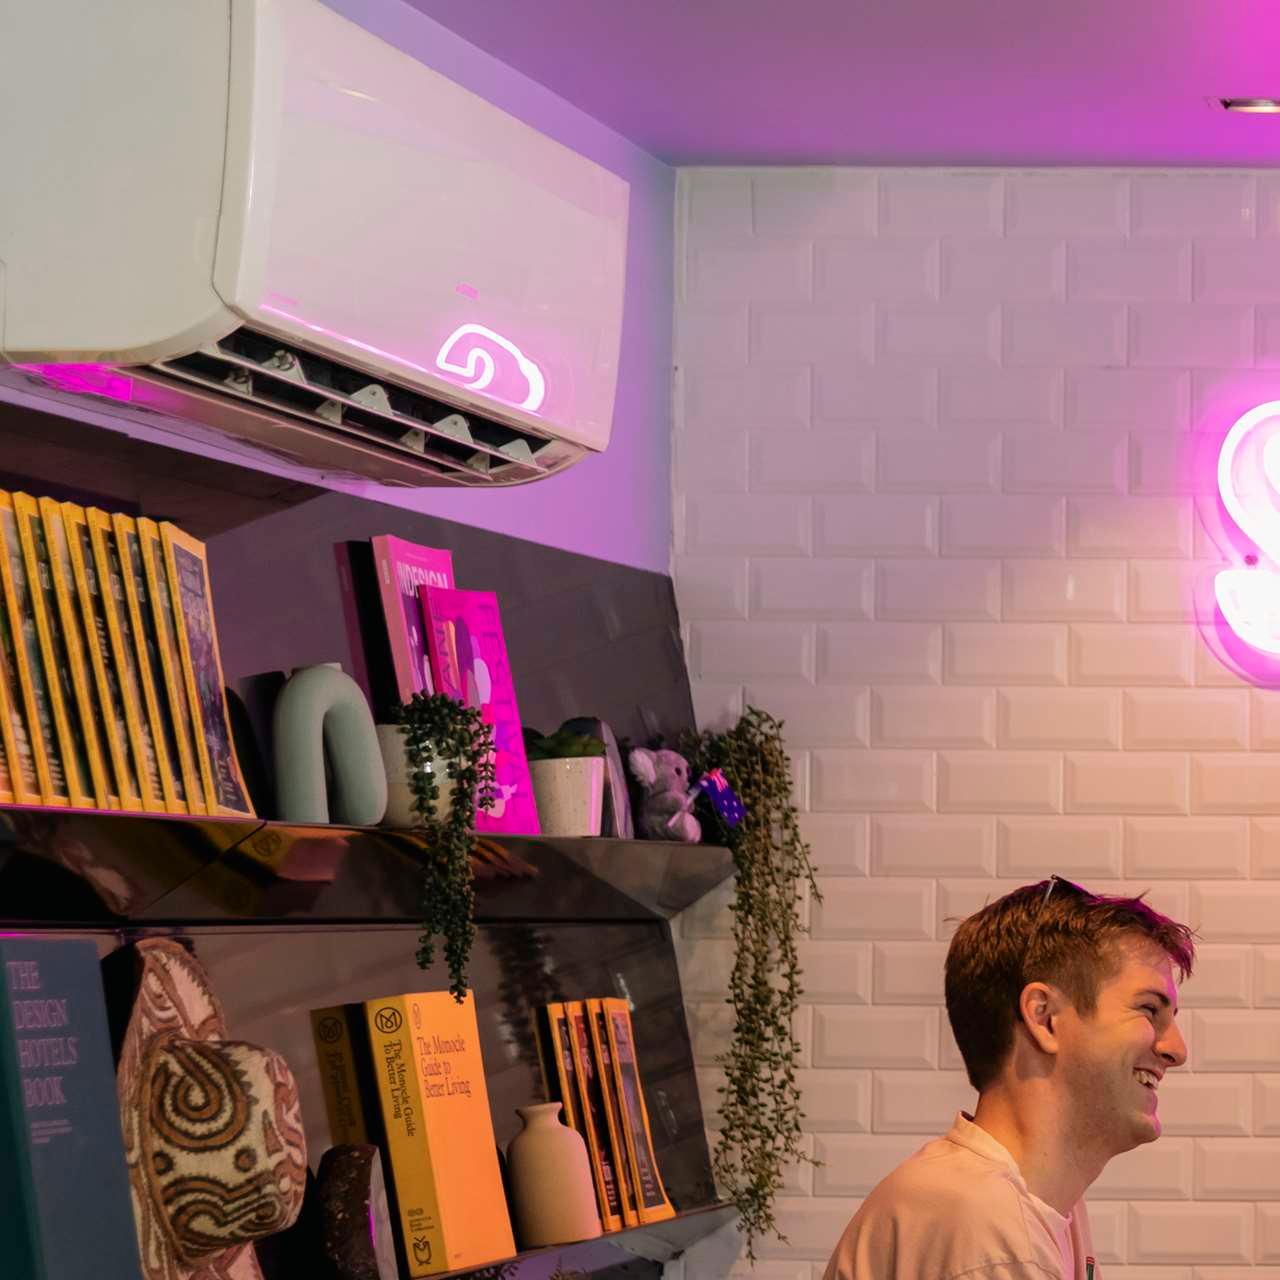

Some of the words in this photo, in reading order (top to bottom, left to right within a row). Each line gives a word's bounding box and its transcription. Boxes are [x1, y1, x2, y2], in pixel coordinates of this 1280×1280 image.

[6, 961, 41, 990] THE
[12, 999, 69, 1029] DESIGN
[17, 1037, 79, 1068] HOTELS
[384, 1040, 393, 1055] To
[391, 1039, 401, 1061] The
[417, 1036, 432, 1056] The
[432, 1033, 467, 1054] Monocle
[385, 1055, 398, 1086] Better
[420, 1058, 442, 1077] Guide
[23, 1076, 67, 1107] BOOK
[395, 1061, 410, 1106] Monocle
[424, 1079, 445, 1099] Better
[445, 1077, 472, 1098] Living
[391, 1086, 402, 1120] Living
[403, 1107, 416, 1137] Guide
